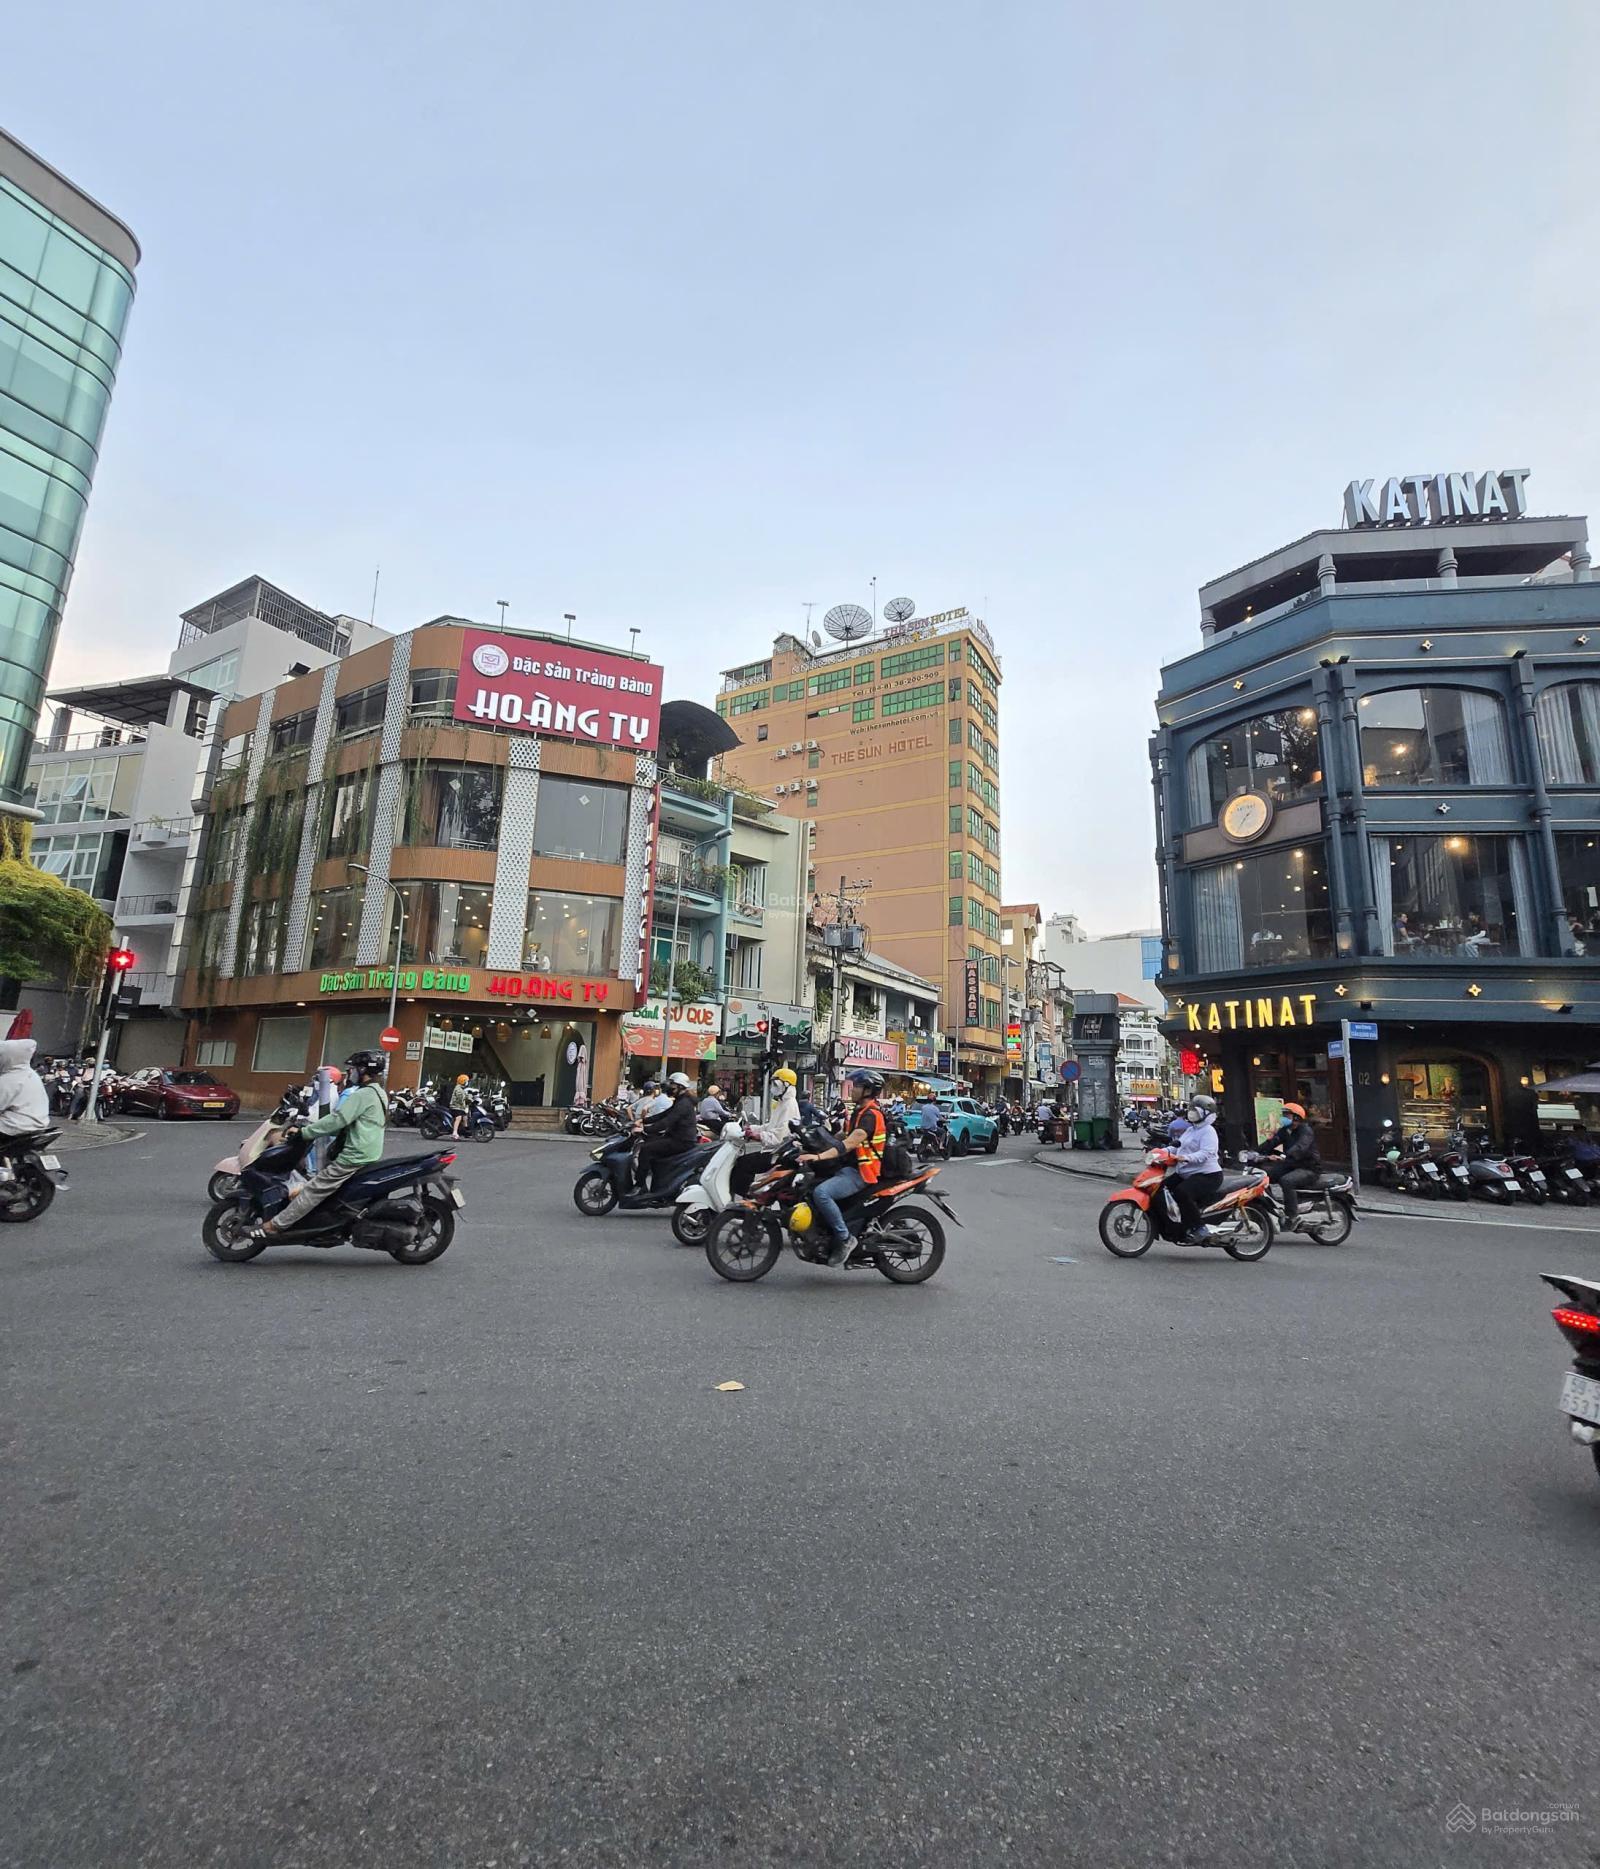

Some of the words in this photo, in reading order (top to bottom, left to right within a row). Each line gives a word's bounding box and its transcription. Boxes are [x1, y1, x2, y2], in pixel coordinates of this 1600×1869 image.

[1346, 468, 1530, 526] KATINAT
[930, 607, 970, 626] HOTEL
[513, 656, 540, 676] Đặc
[544, 660, 571, 681] Sản
[575, 668, 615, 690] Trảng
[467, 689, 600, 738] HOÀNG
[609, 711, 650, 744] TY
[831, 750, 855, 765] THE
[857, 744, 882, 760] SUN
[889, 736, 933, 754] HOTEL
[966, 961, 978, 1018] MASSAGE
[1187, 995, 1316, 1031] KATINAT
[1358, 1072, 1370, 1086] 02
